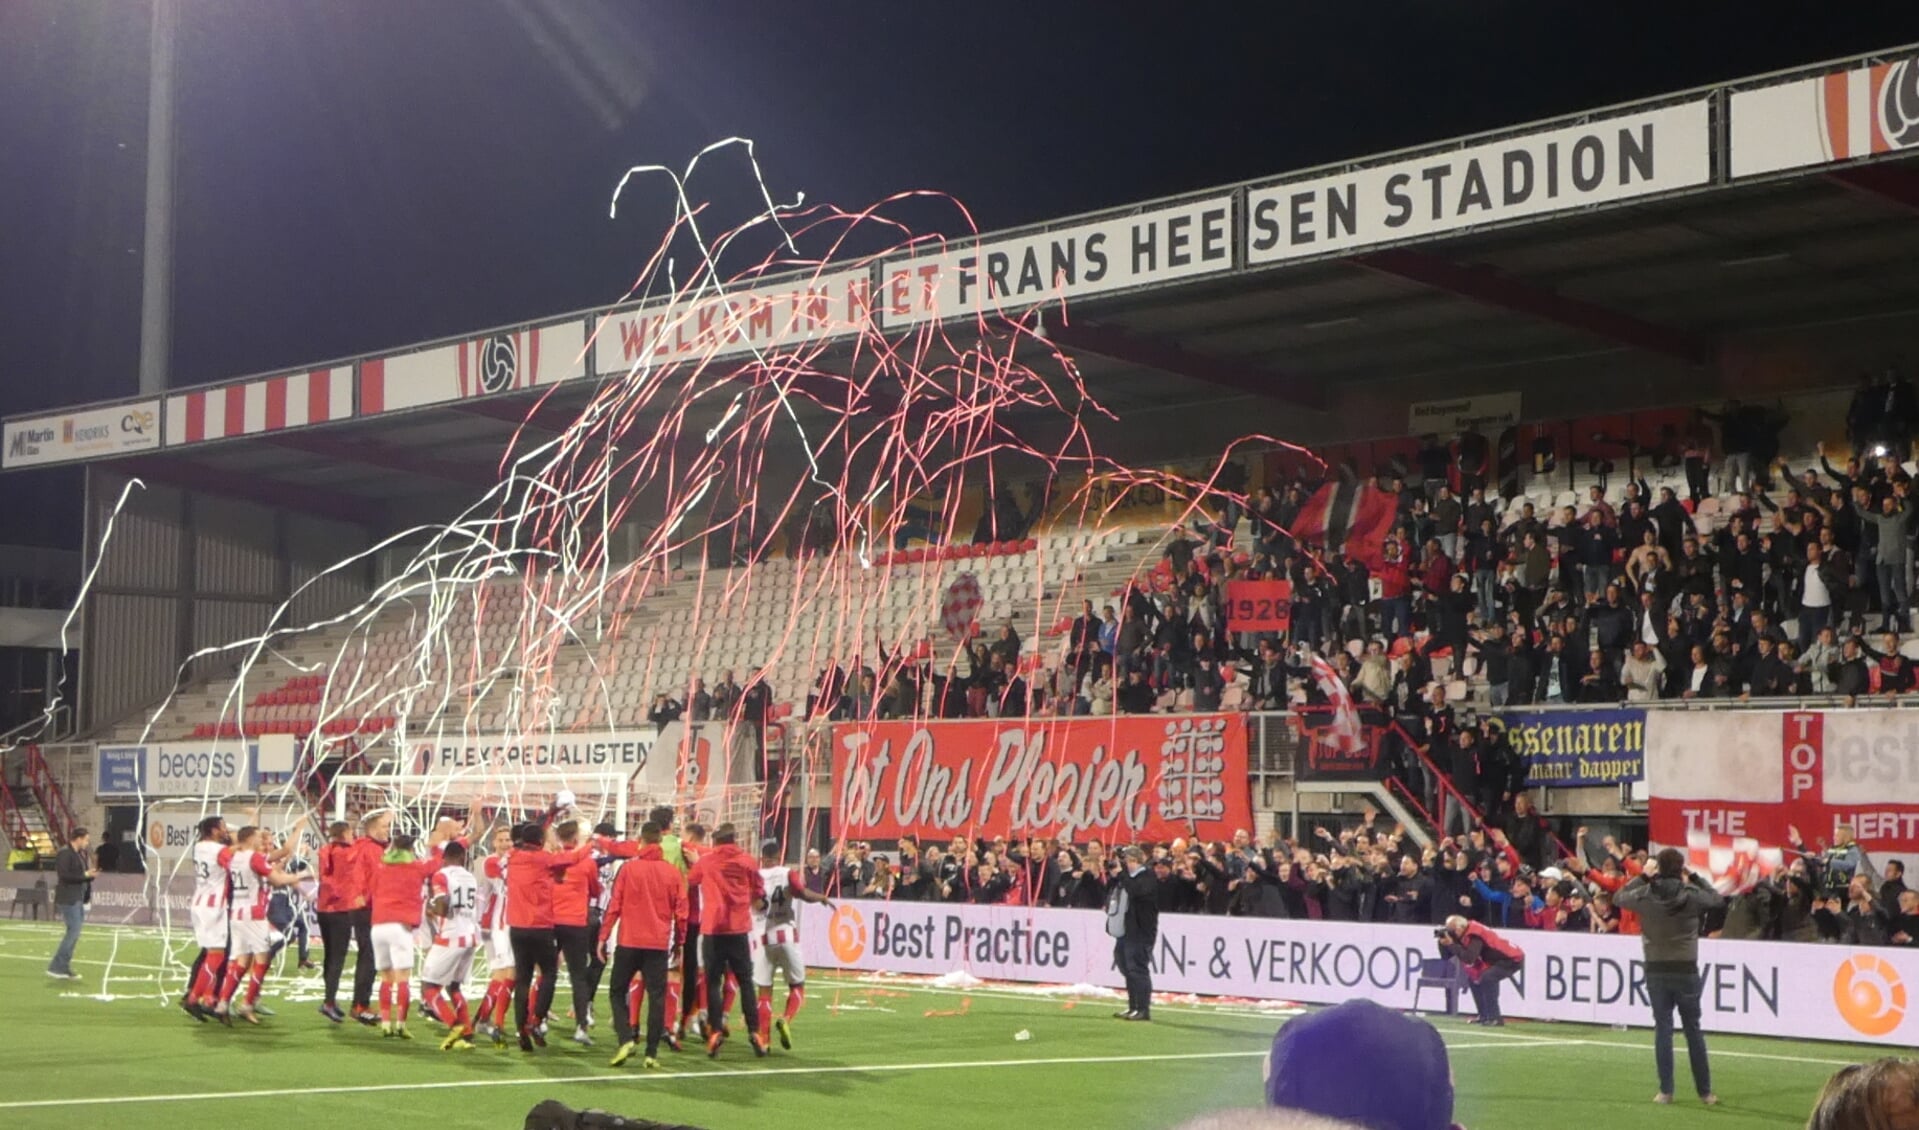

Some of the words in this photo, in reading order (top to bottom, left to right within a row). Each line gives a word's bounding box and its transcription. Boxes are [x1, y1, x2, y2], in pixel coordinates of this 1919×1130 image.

[619, 295, 773, 361] WELKOM
[791, 283, 828, 334] IN
[959, 232, 1107, 304] FRANS
[1384, 123, 1654, 228] STADION
[27, 427, 54, 444] Martin
[159, 745, 235, 778] becoss
[441, 741, 653, 768] FLEXSPECIALISTEN
[1579, 757, 1641, 782] dapper
[1790, 714, 1817, 799] TOP
[893, 727, 974, 830] Ons
[979, 727, 1149, 843] Plezier
[166, 825, 190, 846] Best
[1682, 809, 1746, 836] THE
[453, 886, 475, 909] 15
[872, 911, 934, 960] Best
[944, 916, 1070, 968] Practice
[1208, 936, 1232, 980] &
[1245, 937, 1424, 991] VERKOOP
[1546, 954, 1779, 1018] BEDREN
